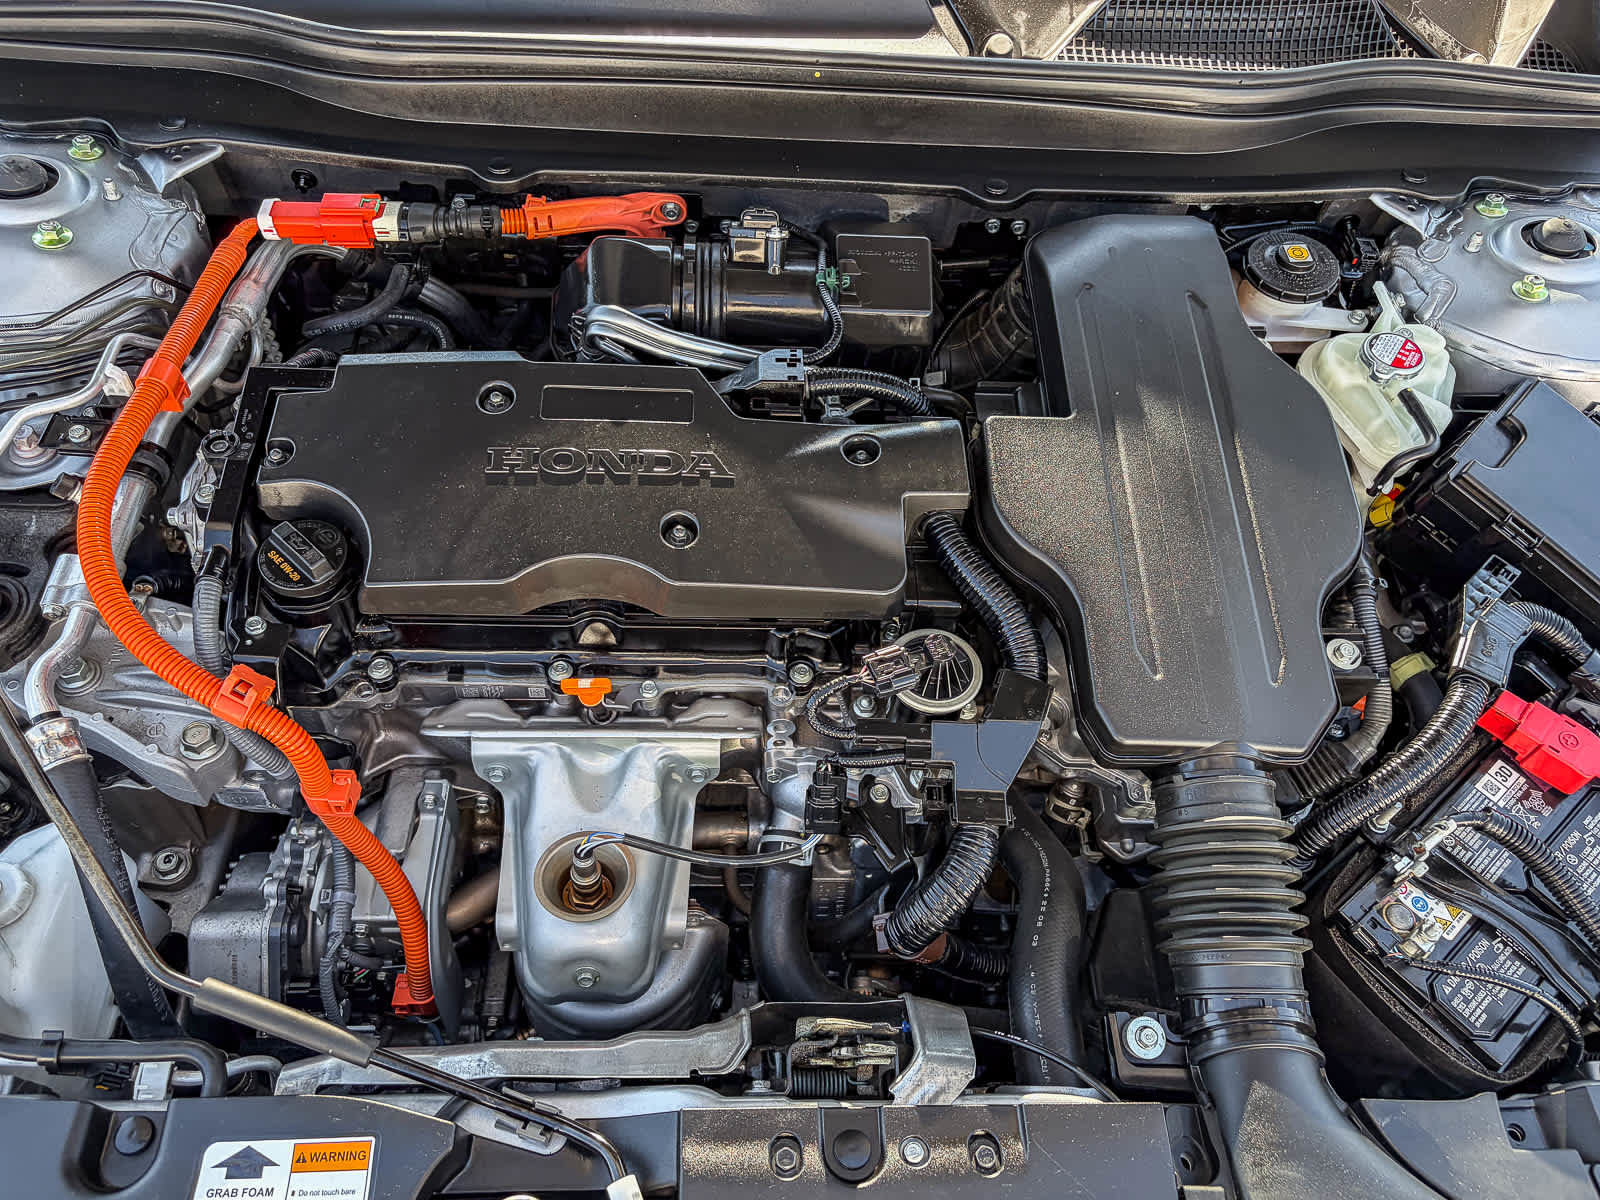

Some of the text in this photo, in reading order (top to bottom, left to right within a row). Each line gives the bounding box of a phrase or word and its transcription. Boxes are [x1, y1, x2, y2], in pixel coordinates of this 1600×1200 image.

[484, 446, 736, 487] HONDA
[267, 550, 301, 582] SAE 0W-20
[1495, 765, 1512, 782] 3D
[1562, 830, 1581, 851] POISON
[1469, 938, 1490, 961] POISON
[309, 1150, 367, 1163] WARNING
[206, 1186, 275, 1198] GRAB FOAM
[298, 1189, 308, 1197] Do
[309, 1189, 320, 1197] not
